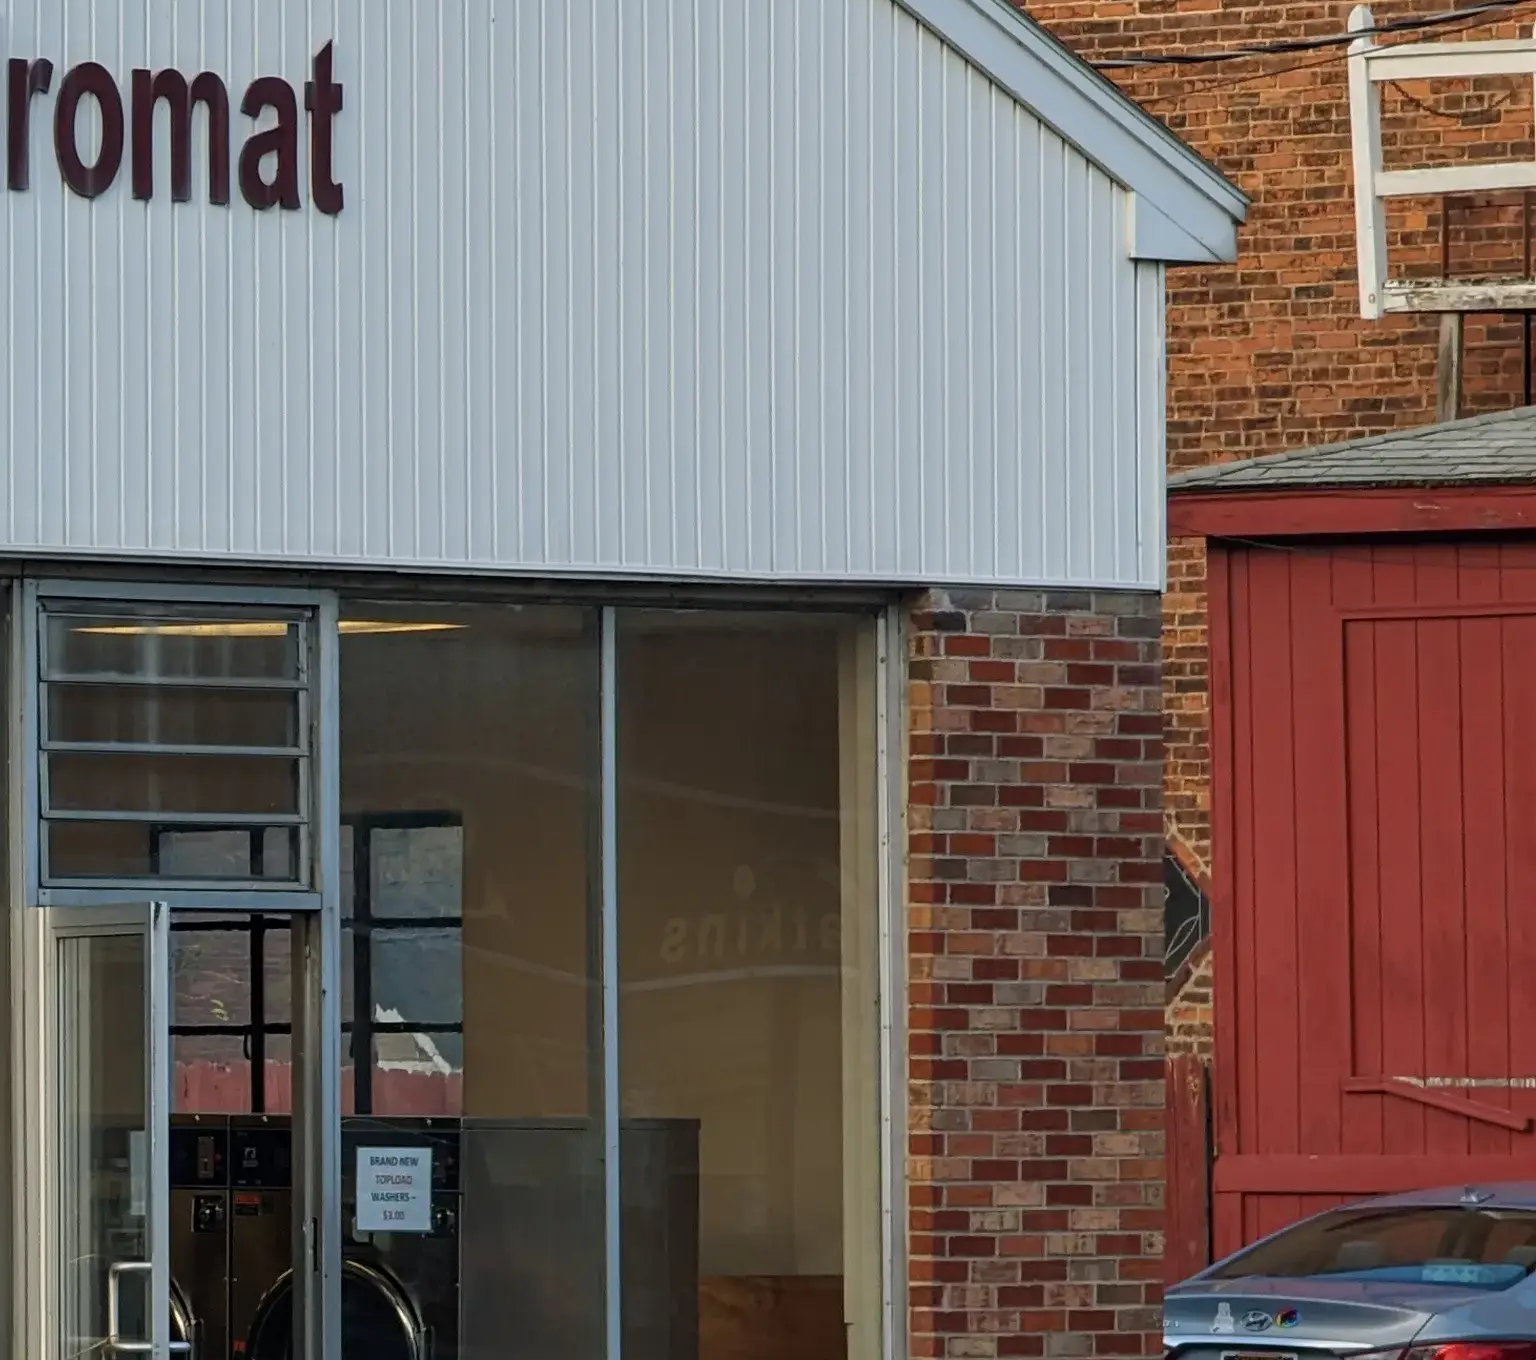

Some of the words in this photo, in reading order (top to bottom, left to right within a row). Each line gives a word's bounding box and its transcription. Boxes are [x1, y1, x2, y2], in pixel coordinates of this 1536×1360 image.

[369, 1156, 398, 1167] BRAND
[399, 1156, 420, 1167] NEW
[375, 1175, 413, 1185] TOPLOAD
[370, 1192, 410, 1202] WASHERS
